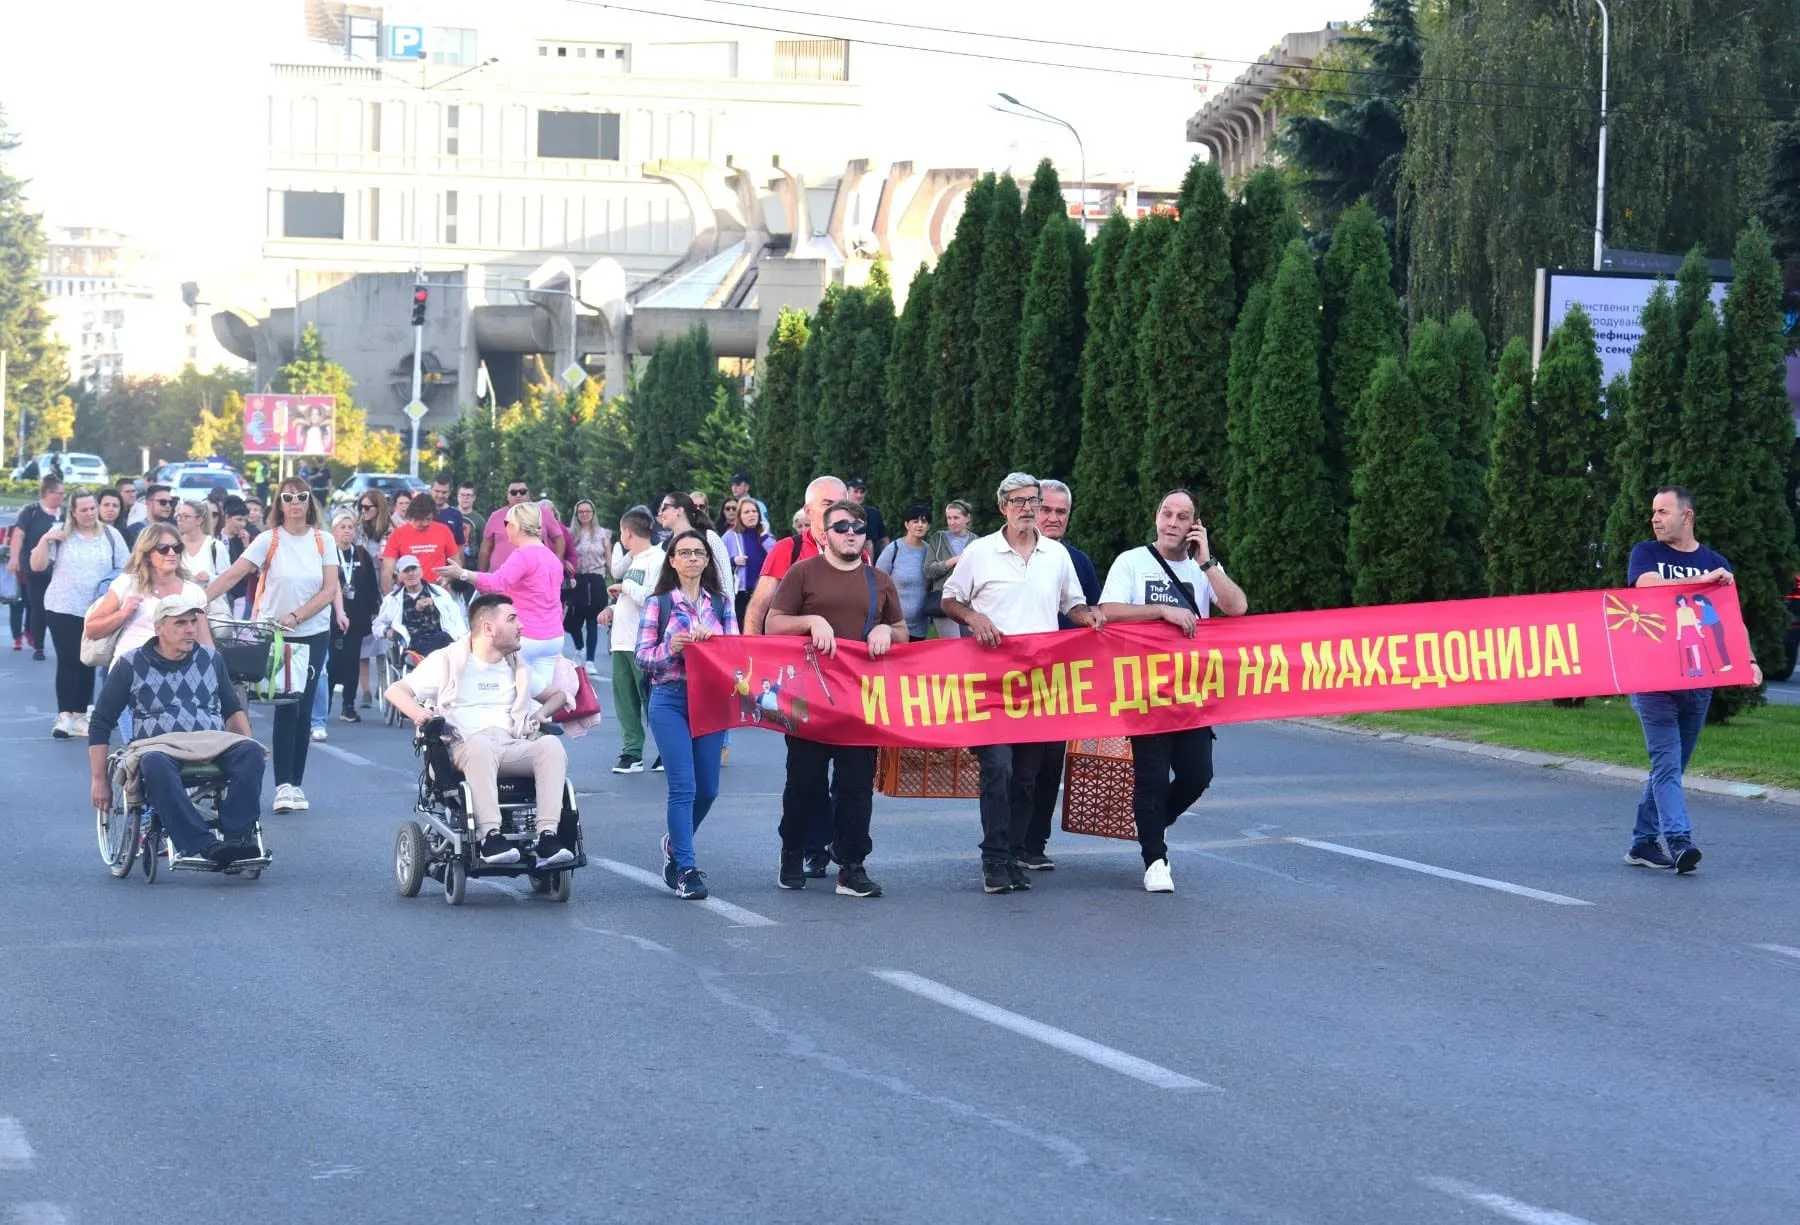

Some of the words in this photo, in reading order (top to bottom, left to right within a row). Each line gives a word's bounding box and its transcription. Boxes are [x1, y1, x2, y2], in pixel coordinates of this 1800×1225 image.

[394, 29, 420, 55] P
[1564, 299, 1630, 313] Еинствени
[1592, 329, 1644, 342] нефиции
[1605, 344, 1637, 354] семеј
[1149, 584, 1164, 593] The
[1150, 592, 1179, 604] Office
[861, 674, 890, 726] И
[900, 672, 991, 727] НИЕ
[1002, 659, 1097, 719] СМЕ
[1109, 648, 1225, 717] ДЕЦА
[1237, 643, 1290, 697] НА
[1301, 622, 1582, 691] МАКЕДОНИЈА!
